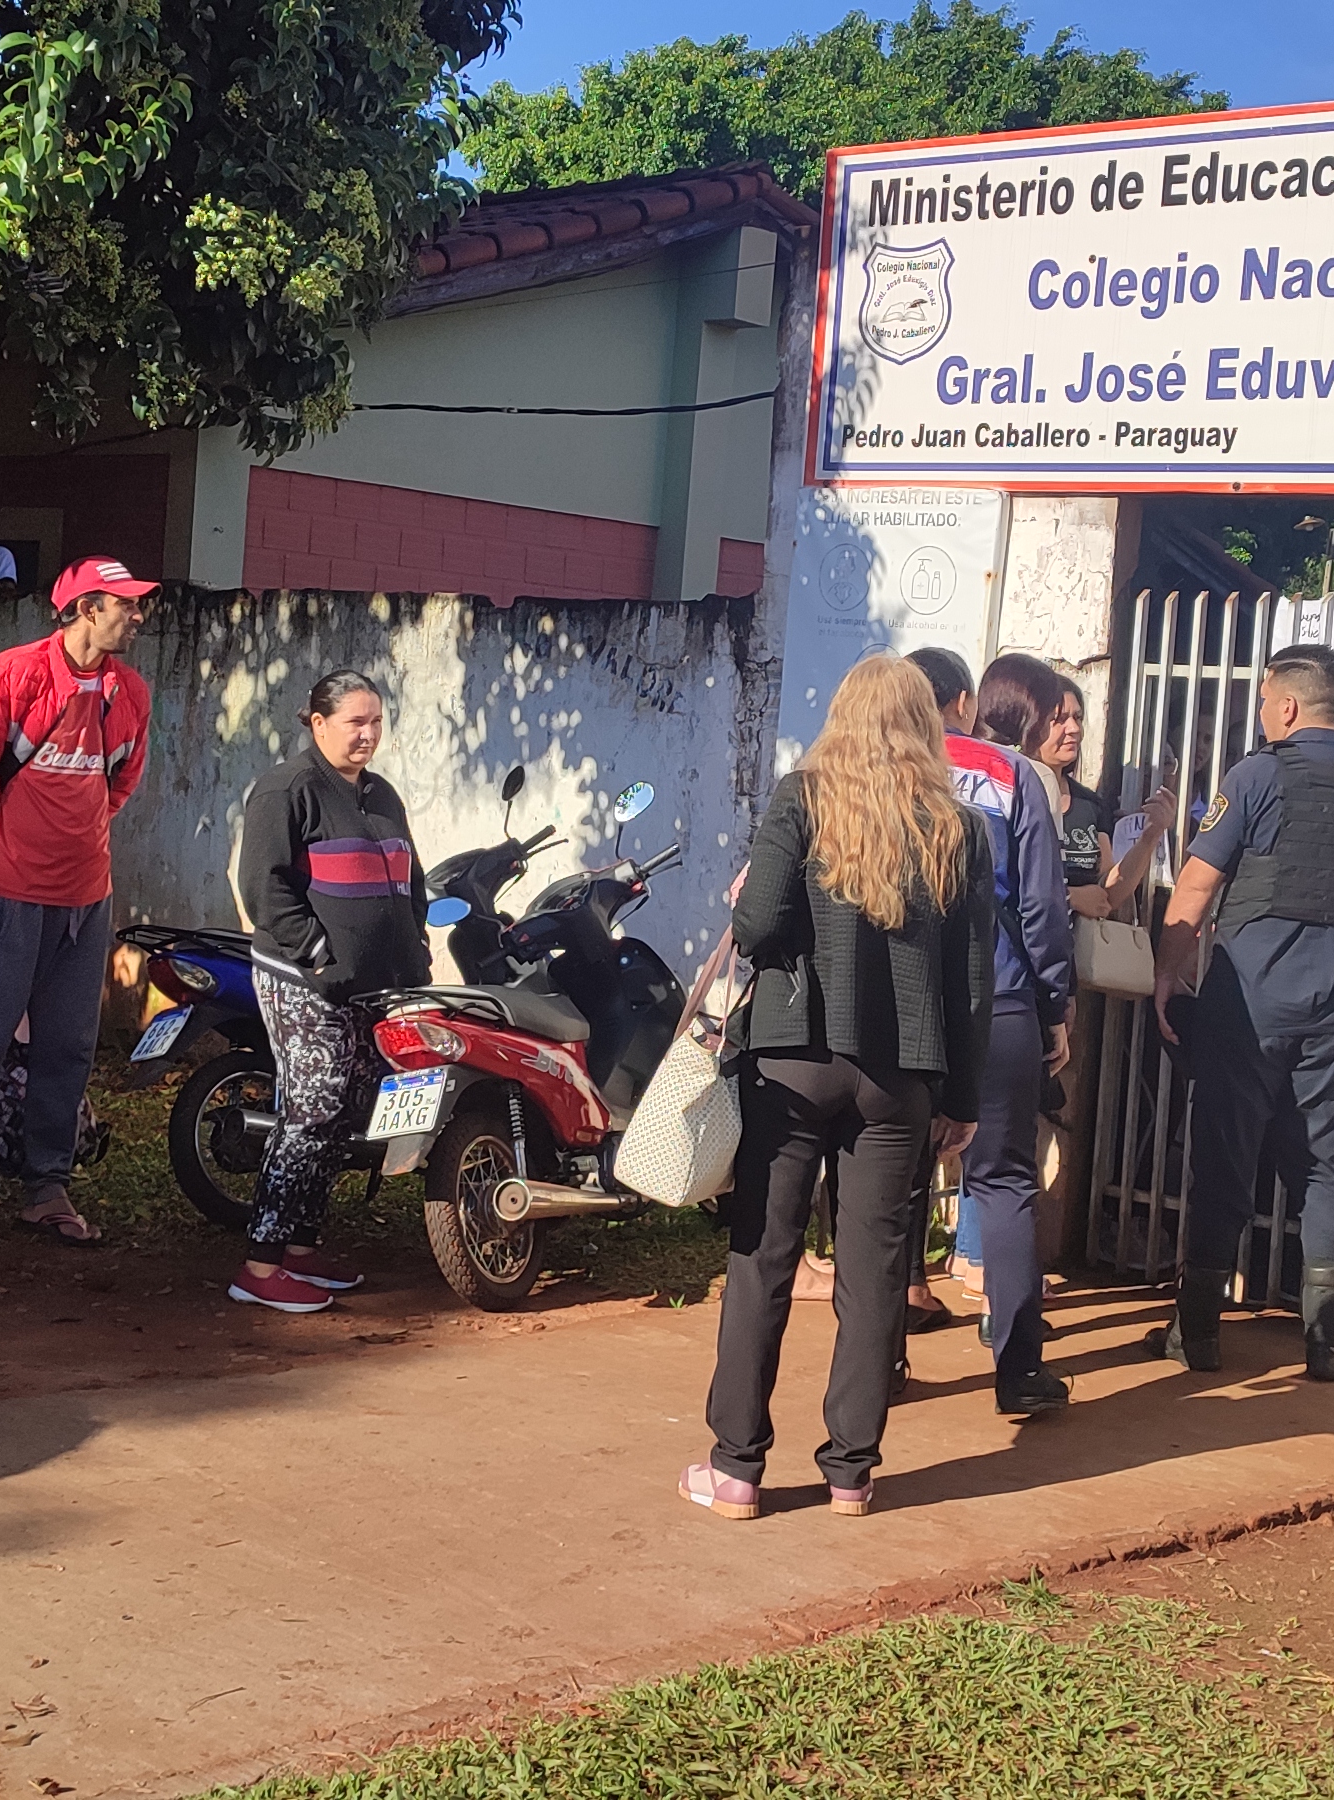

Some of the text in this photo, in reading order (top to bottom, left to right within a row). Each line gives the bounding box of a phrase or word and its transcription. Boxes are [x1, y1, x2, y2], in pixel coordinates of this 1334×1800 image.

[868, 165, 1074, 227] Ministerio
[1090, 160, 1144, 212] de
[877, 258, 940, 274] Colegio Nacional
[1028, 251, 1220, 319] Colegio
[872, 325, 936, 338] Pedro J. Caballero
[936, 353, 1046, 405] Gral.
[1064, 350, 1187, 403] José
[841, 423, 905, 448] Pedro
[911, 424, 966, 448] Juan
[974, 422, 1090, 448] Caballero
[1114, 421, 1238, 454] Paraguay
[921, 491, 942, 505] EN
[945, 491, 983, 506] ESTE
[873, 511, 962, 528] HABILITADO:
[384, 1088, 425, 1111] 305
[376, 1107, 429, 1132] AAXG
